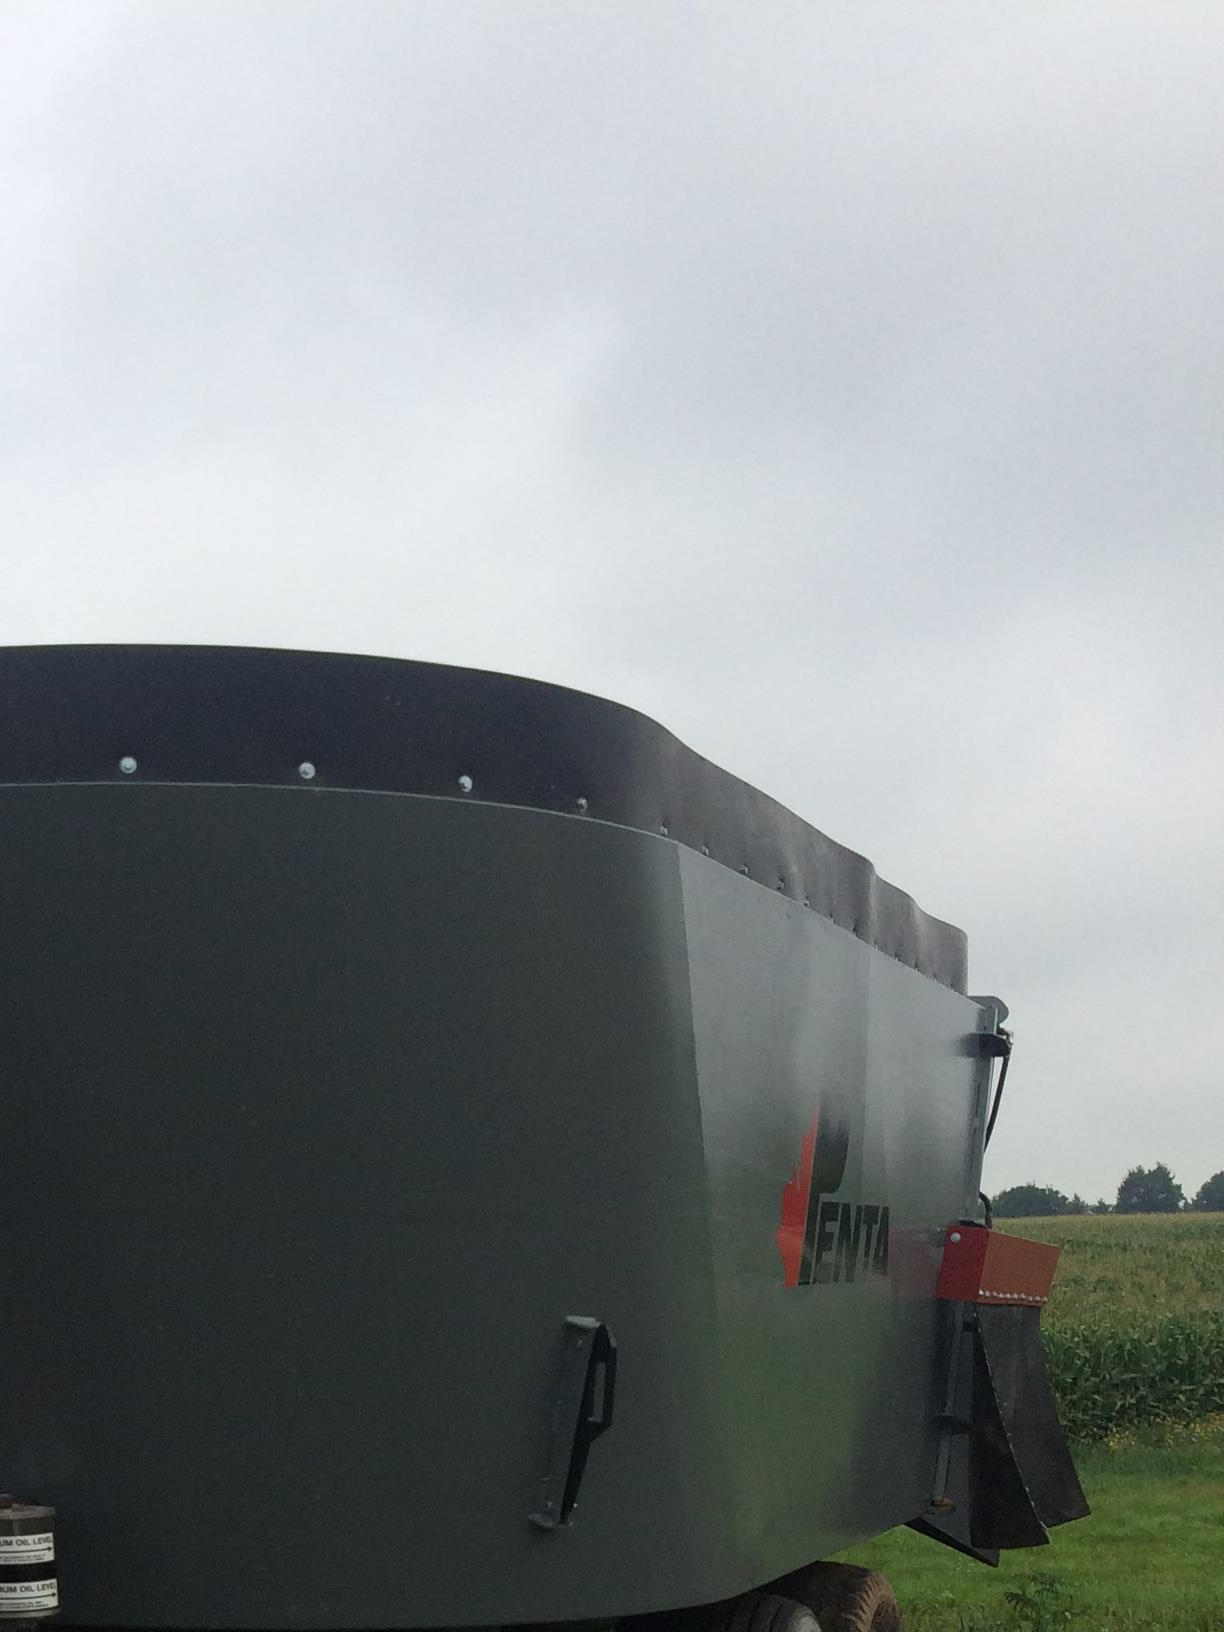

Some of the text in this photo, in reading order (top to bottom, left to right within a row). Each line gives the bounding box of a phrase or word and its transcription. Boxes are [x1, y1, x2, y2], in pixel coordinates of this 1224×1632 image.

[797, 1102, 891, 1287] PENTA
[15, 1538, 31, 1547] OIL
[19, 1584, 35, 1593] OIL
